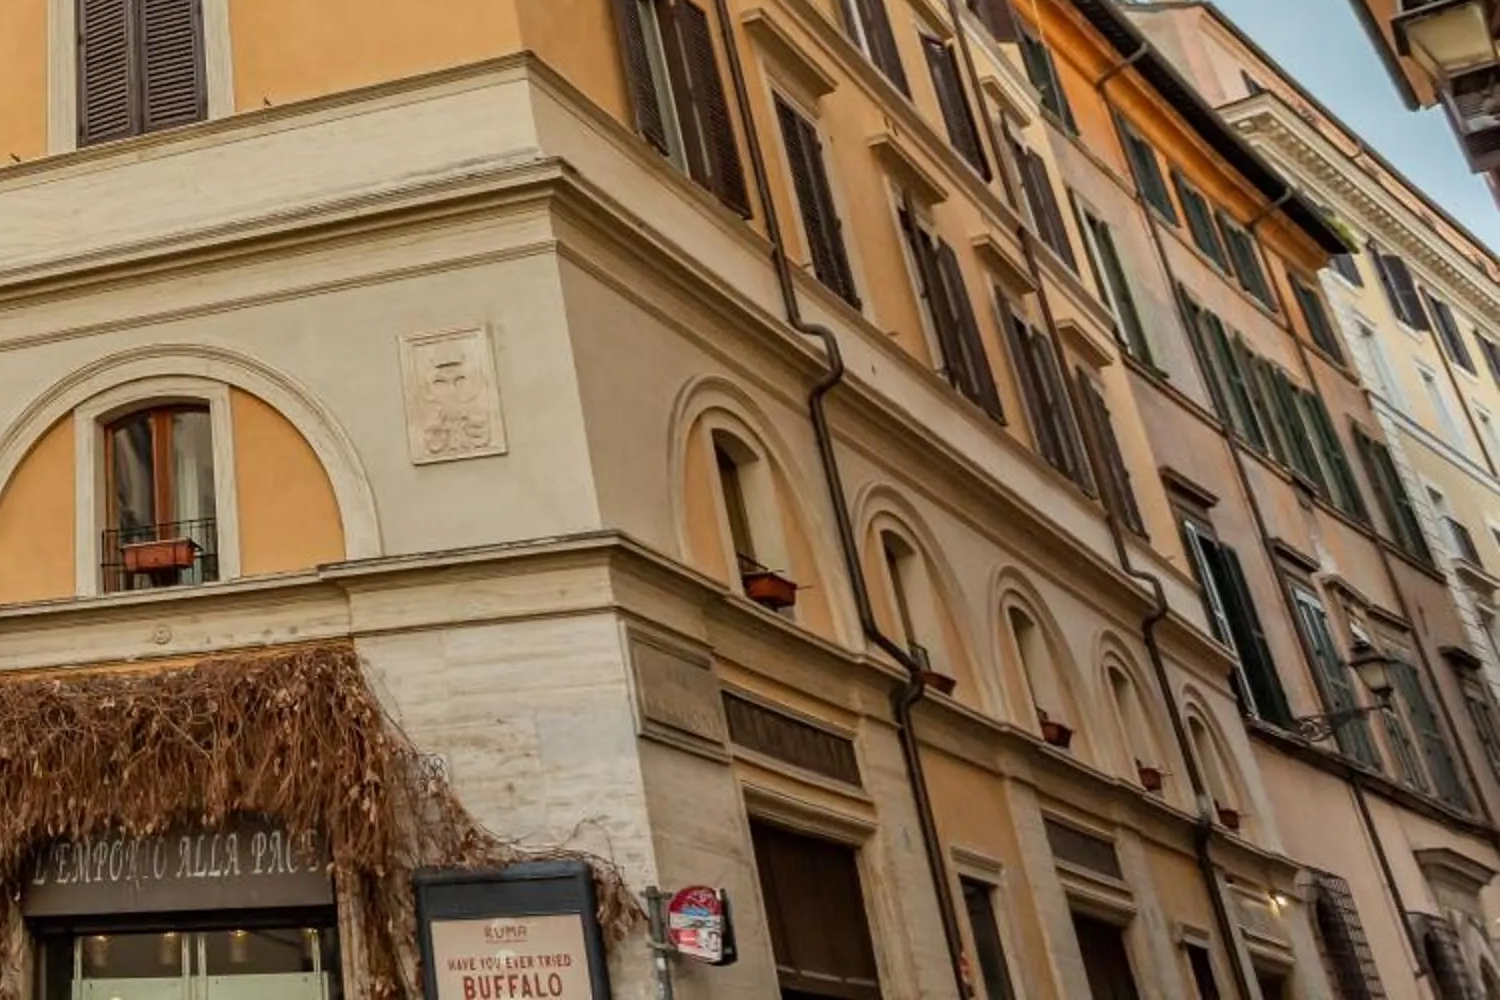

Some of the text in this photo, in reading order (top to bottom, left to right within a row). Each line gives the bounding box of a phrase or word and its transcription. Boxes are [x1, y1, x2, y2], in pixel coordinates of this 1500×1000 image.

[175, 833, 241, 878] ALLA
[447, 956, 477, 971] HAVE
[505, 955, 534, 969] EVER
[538, 952, 571, 967] TRIED
[463, 971, 563, 1000] BUFFALO
